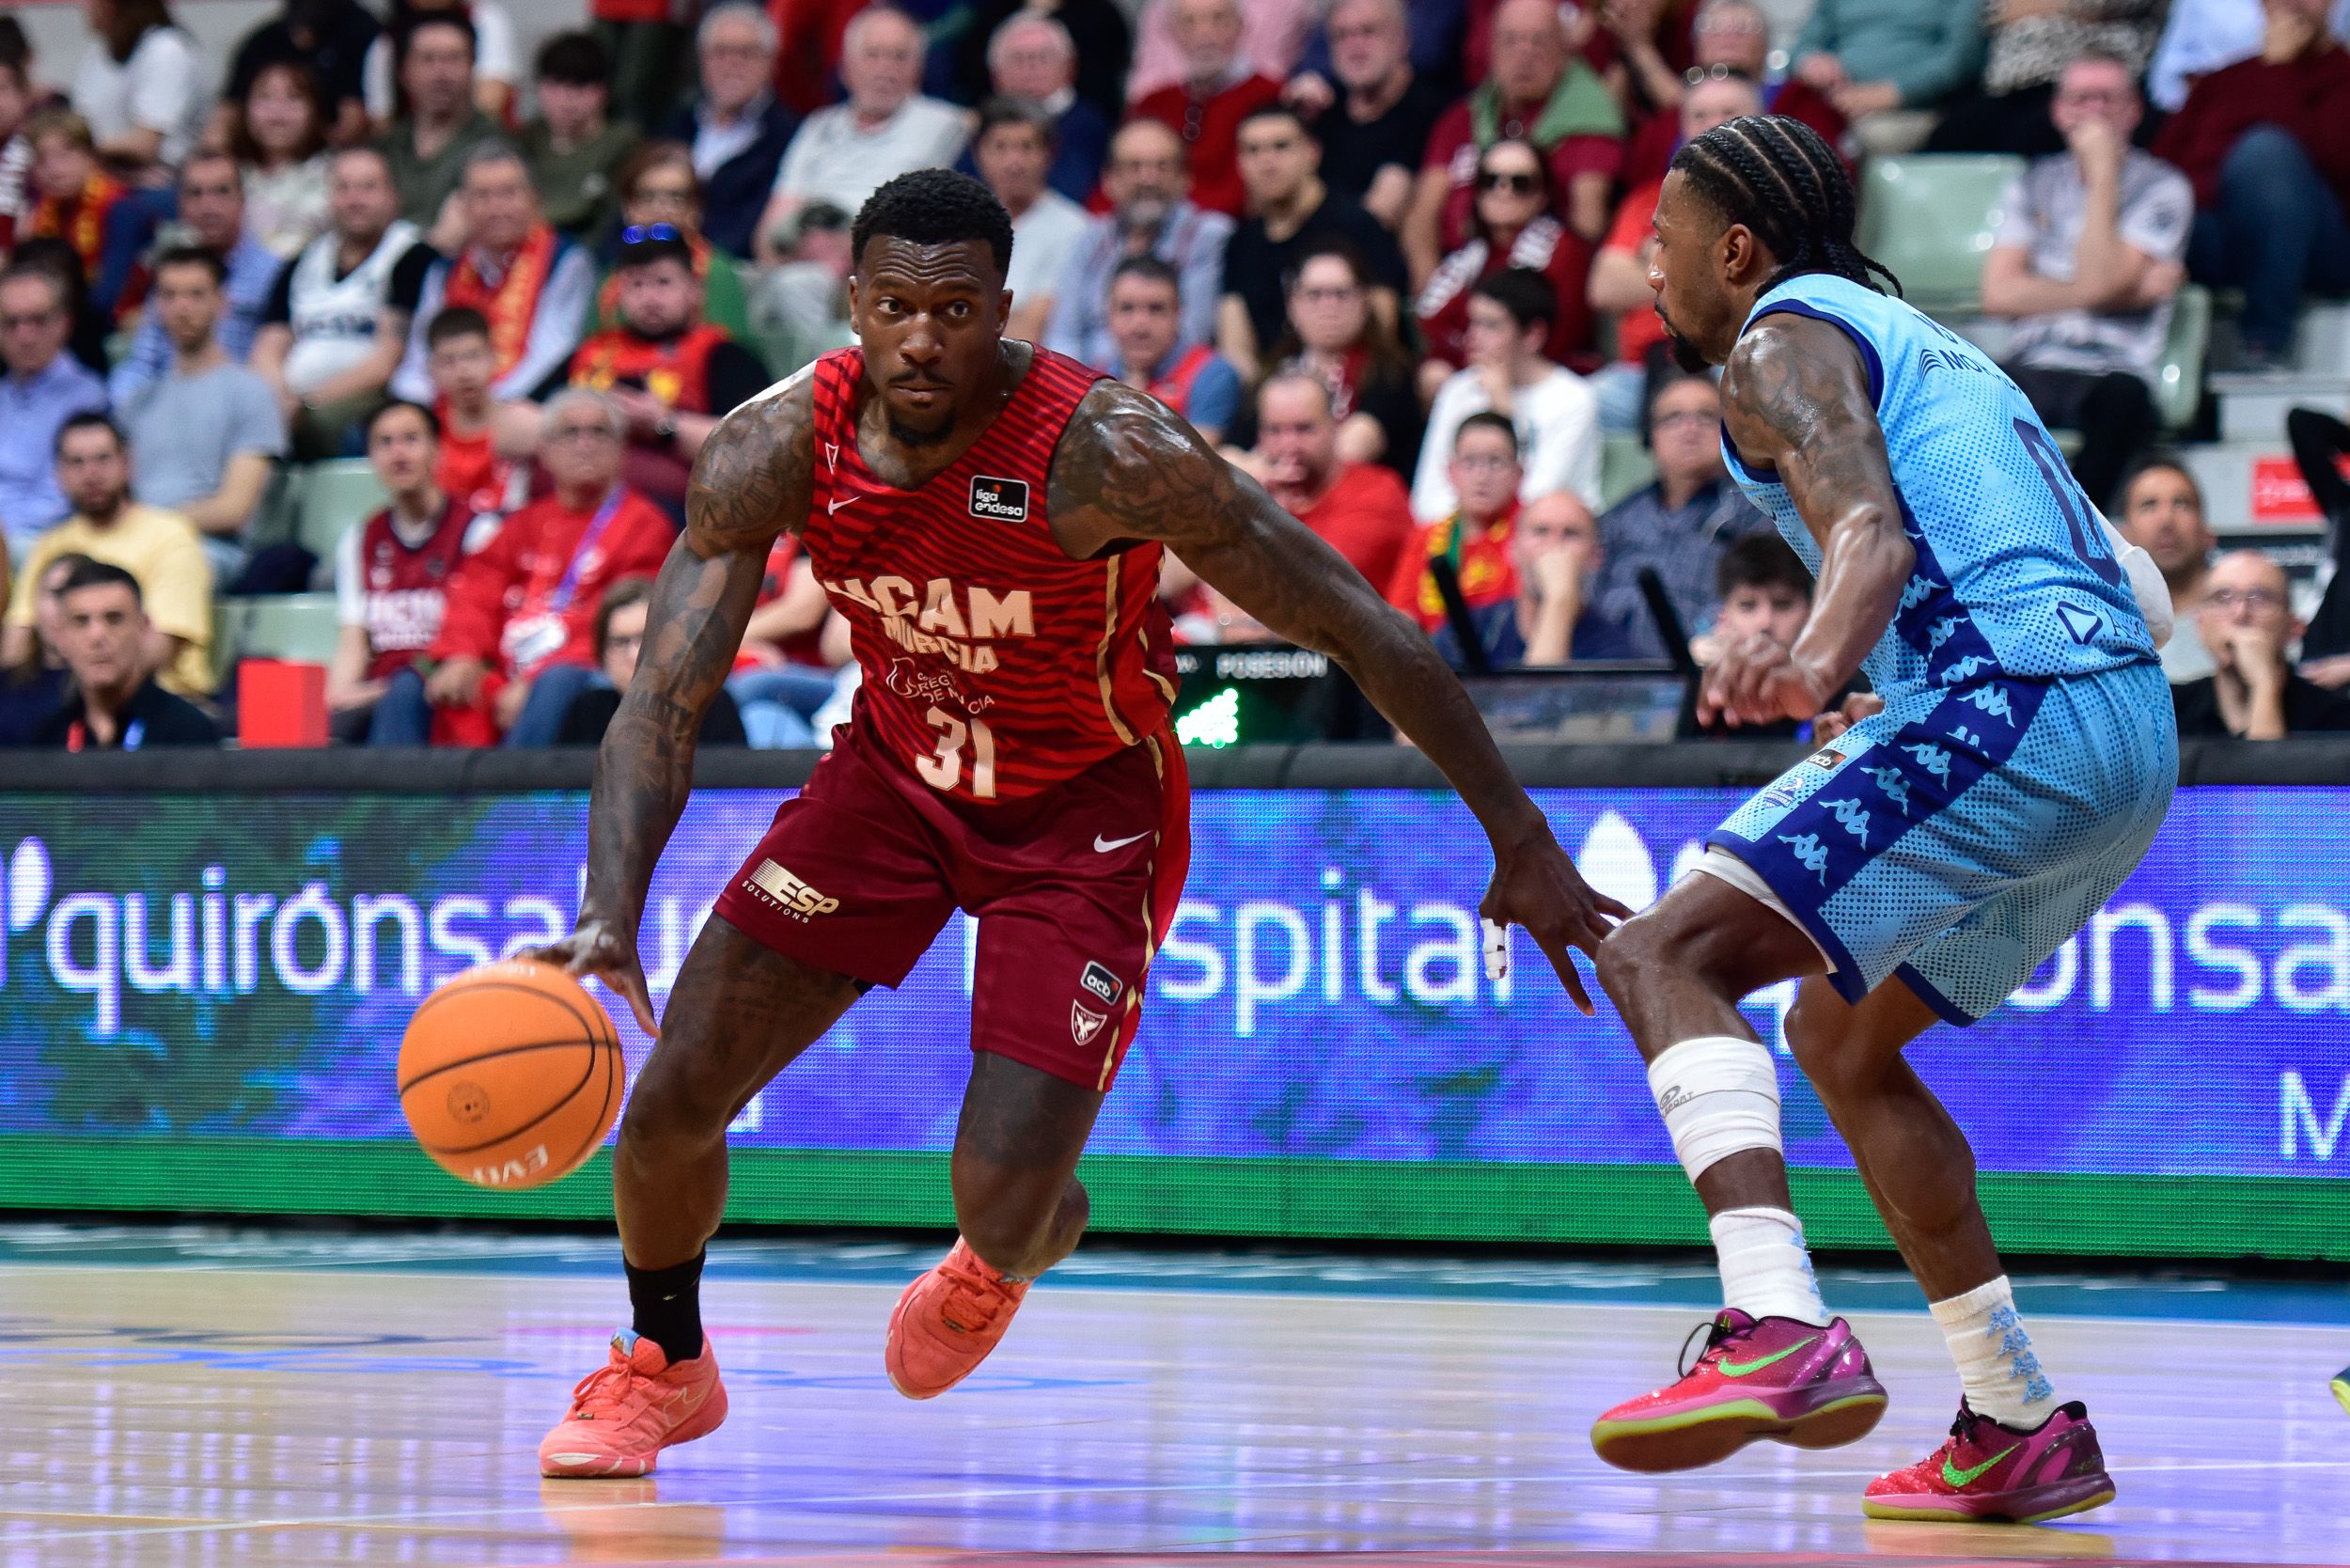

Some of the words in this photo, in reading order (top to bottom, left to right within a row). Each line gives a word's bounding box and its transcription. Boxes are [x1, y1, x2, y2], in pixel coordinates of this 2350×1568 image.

[975, 501, 1023, 516] endesa
[976, 489, 998, 502] liga
[823, 575, 1035, 638] UCAM
[881, 616, 999, 674] MURCIA
[915, 705, 996, 798] 31
[742, 880, 810, 924] SOLUTIONS
[749, 857, 839, 917] ESP
[1087, 975, 1111, 997] acb
